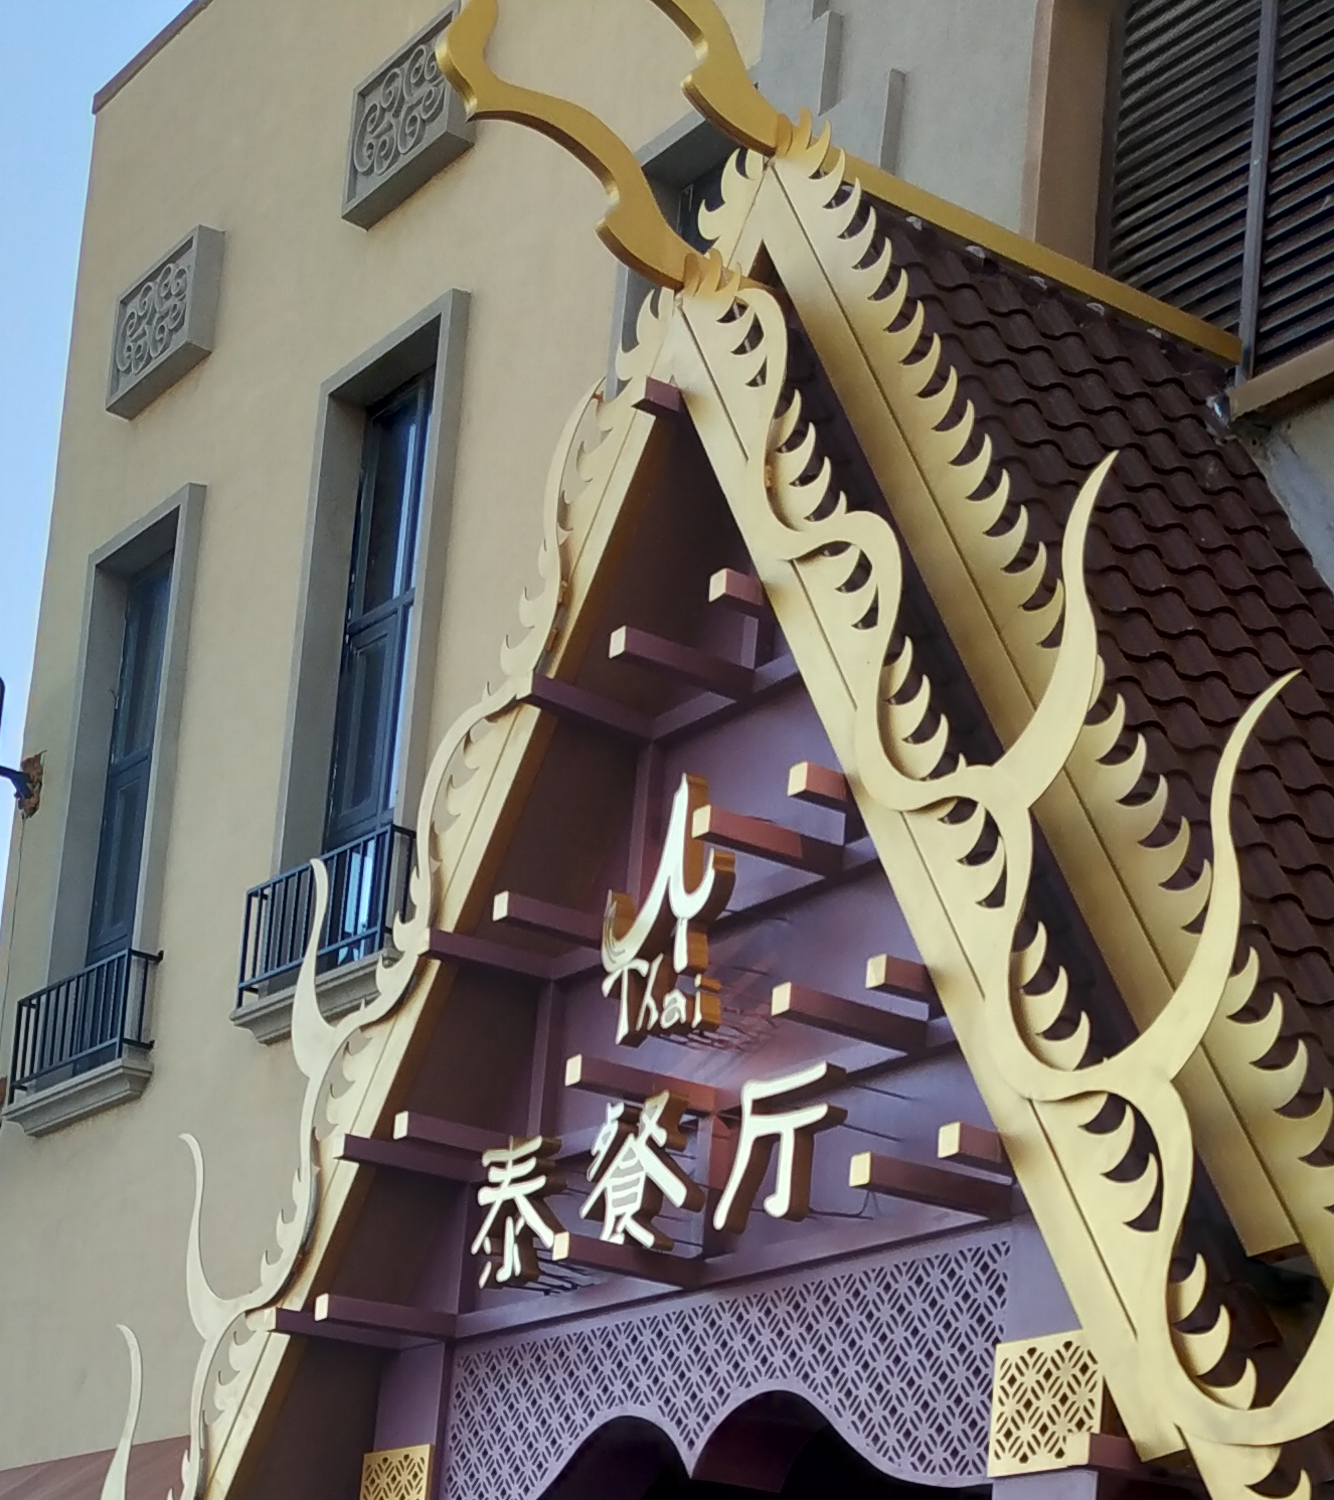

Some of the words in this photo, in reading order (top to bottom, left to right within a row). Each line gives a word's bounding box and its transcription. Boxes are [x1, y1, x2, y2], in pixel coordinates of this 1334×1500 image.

[602, 953, 704, 1045] Thai
[471, 1061, 831, 1289] 泰餐厅
